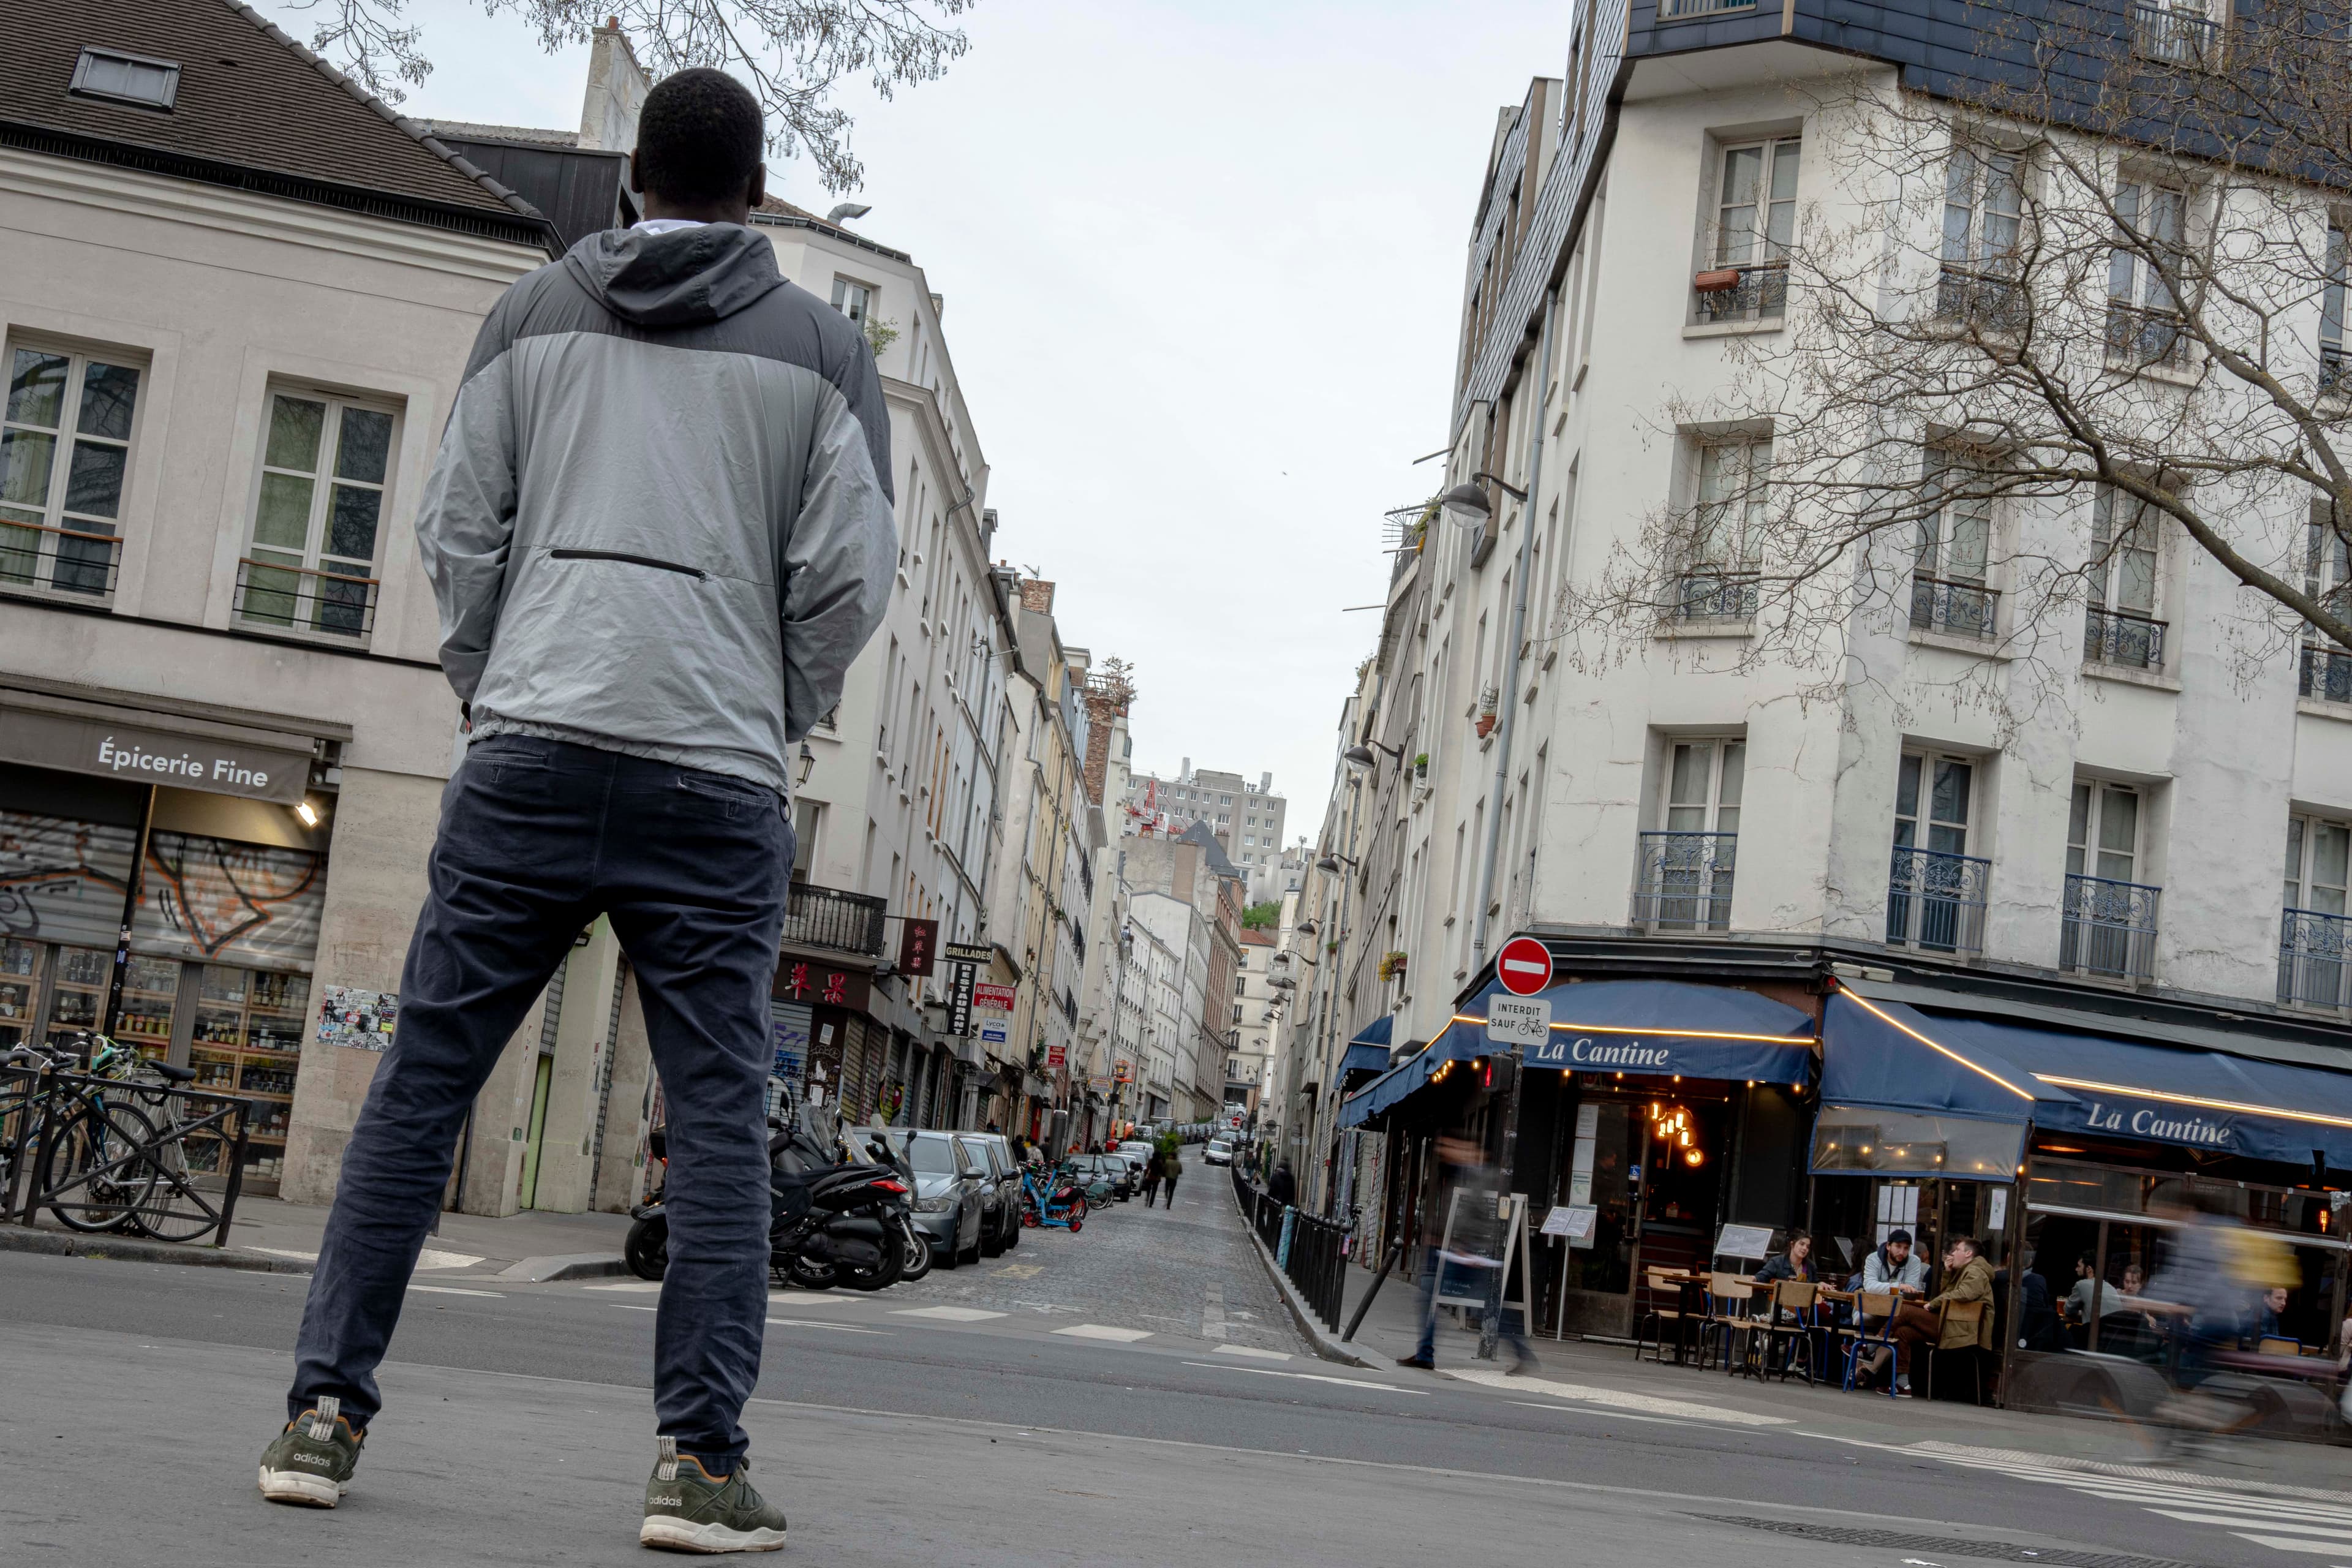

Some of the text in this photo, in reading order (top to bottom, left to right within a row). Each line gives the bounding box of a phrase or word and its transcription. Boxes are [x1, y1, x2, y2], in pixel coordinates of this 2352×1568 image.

[98, 736, 268, 787] Épicerie Fine
[946, 946, 992, 960] GRILLADES
[976, 985, 1014, 998] ALIMENTATION
[953, 964, 972, 1035] RESTAURANT
[979, 996, 1008, 1010] GÉNÉRALE
[1498, 1003, 1541, 1016] INTERDIT
[1491, 1018, 1516, 1029] SAUF
[1537, 1038, 1669, 1066] La Cantine
[2087, 1102, 2230, 1144] La Cantine
[293, 1453, 331, 1467] adidas
[649, 1495, 682, 1507] adidas
